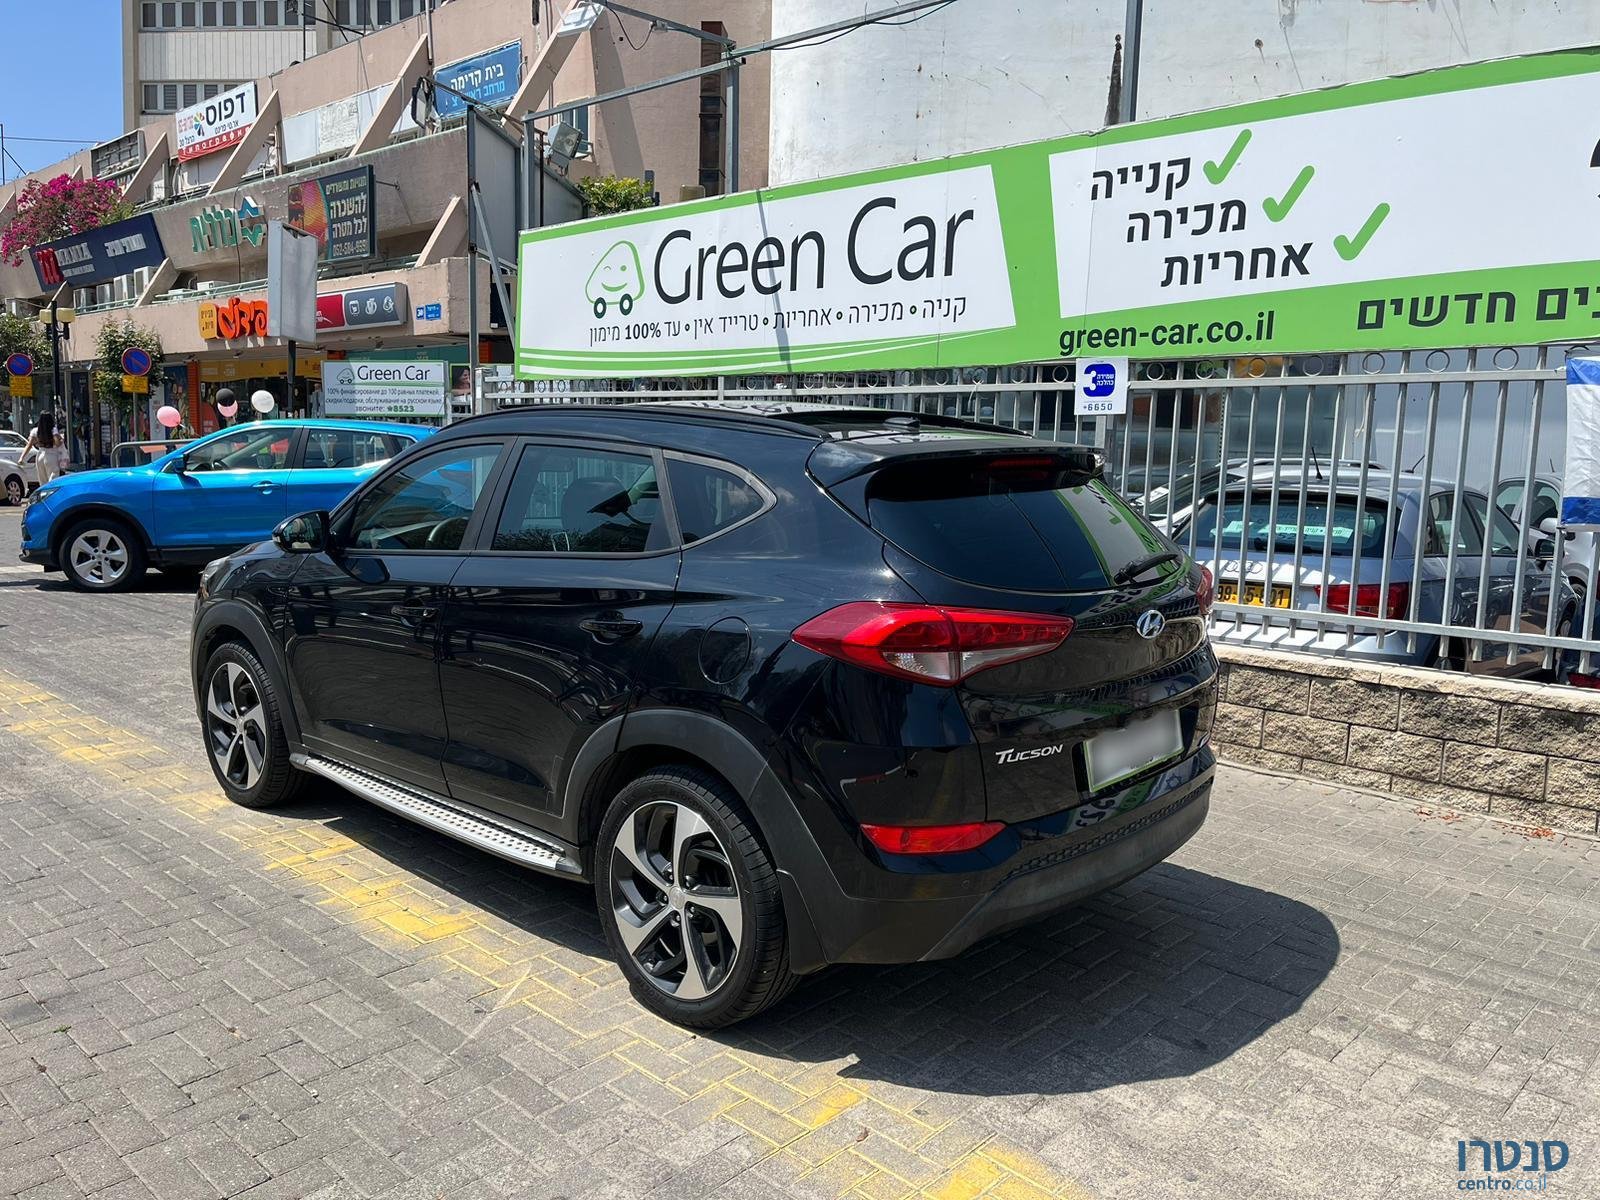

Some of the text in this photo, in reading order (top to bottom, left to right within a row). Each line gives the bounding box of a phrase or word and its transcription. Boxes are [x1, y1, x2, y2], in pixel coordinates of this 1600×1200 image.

[483, 81, 505, 96] מרחב
[485, 64, 504, 81] בית
[205, 92, 246, 126] דפוס
[1091, 157, 1192, 201] קנייה
[330, 192, 367, 220] להשכרה
[332, 216, 368, 239] לכל מטרה
[1127, 199, 1247, 243] מכירה
[190, 205, 241, 253] כללית
[654, 197, 974, 305] Green Car
[1160, 242, 1313, 288] אחריות
[589, 297, 967, 347] קניה מכירה אחריות טרייד אין עד 100% מימון
[1357, 287, 1600, 330] ים חדשים
[1059, 310, 1275, 356] green-car.co.il
[357, 366, 431, 381] Green Car
[995, 743, 1063, 765] TUCSON
